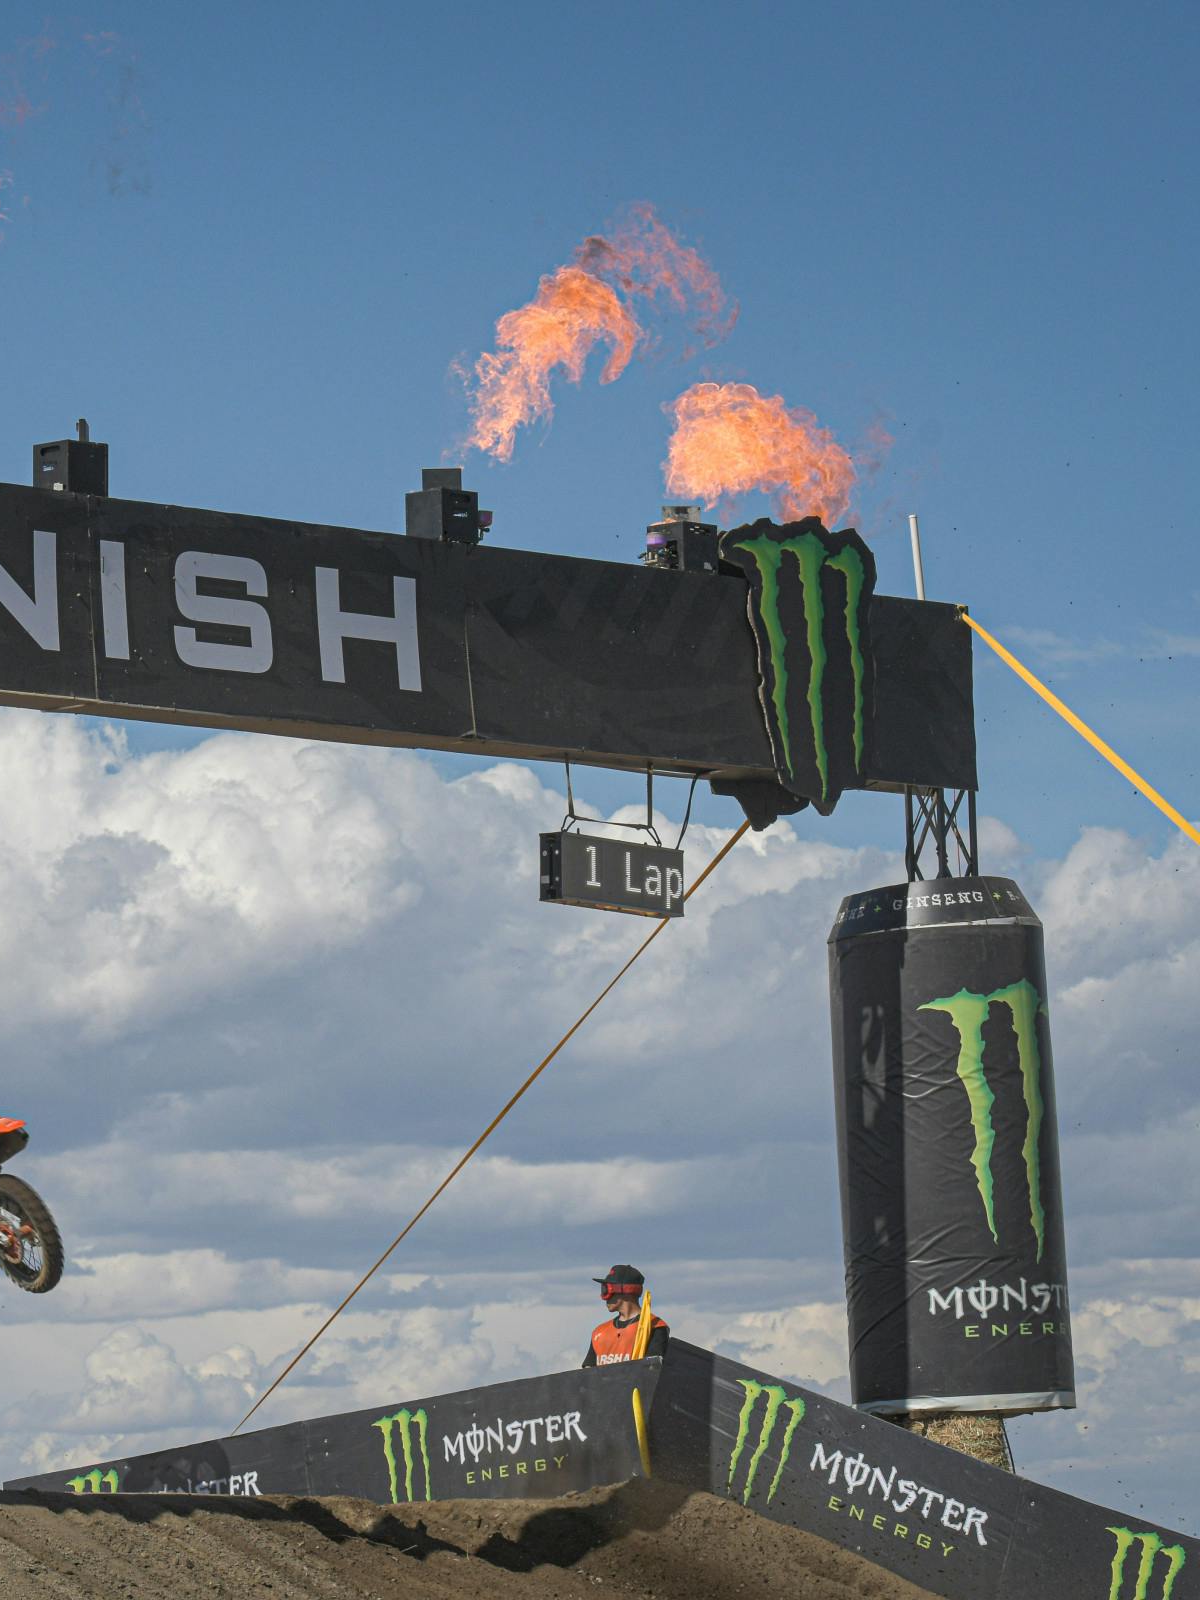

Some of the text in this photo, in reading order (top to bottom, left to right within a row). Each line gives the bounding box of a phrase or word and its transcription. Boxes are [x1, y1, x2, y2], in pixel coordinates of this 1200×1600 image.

[585, 845, 683, 909] 1 Lap
[892, 891, 983, 911] GINSENG
[927, 1277, 1068, 1320] MONST
[442, 1410, 588, 1465] MONSTER
[466, 1456, 565, 1485] ENERGY
[809, 1442, 989, 1546] MONSTER
[828, 1495, 954, 1557] ENERGY
